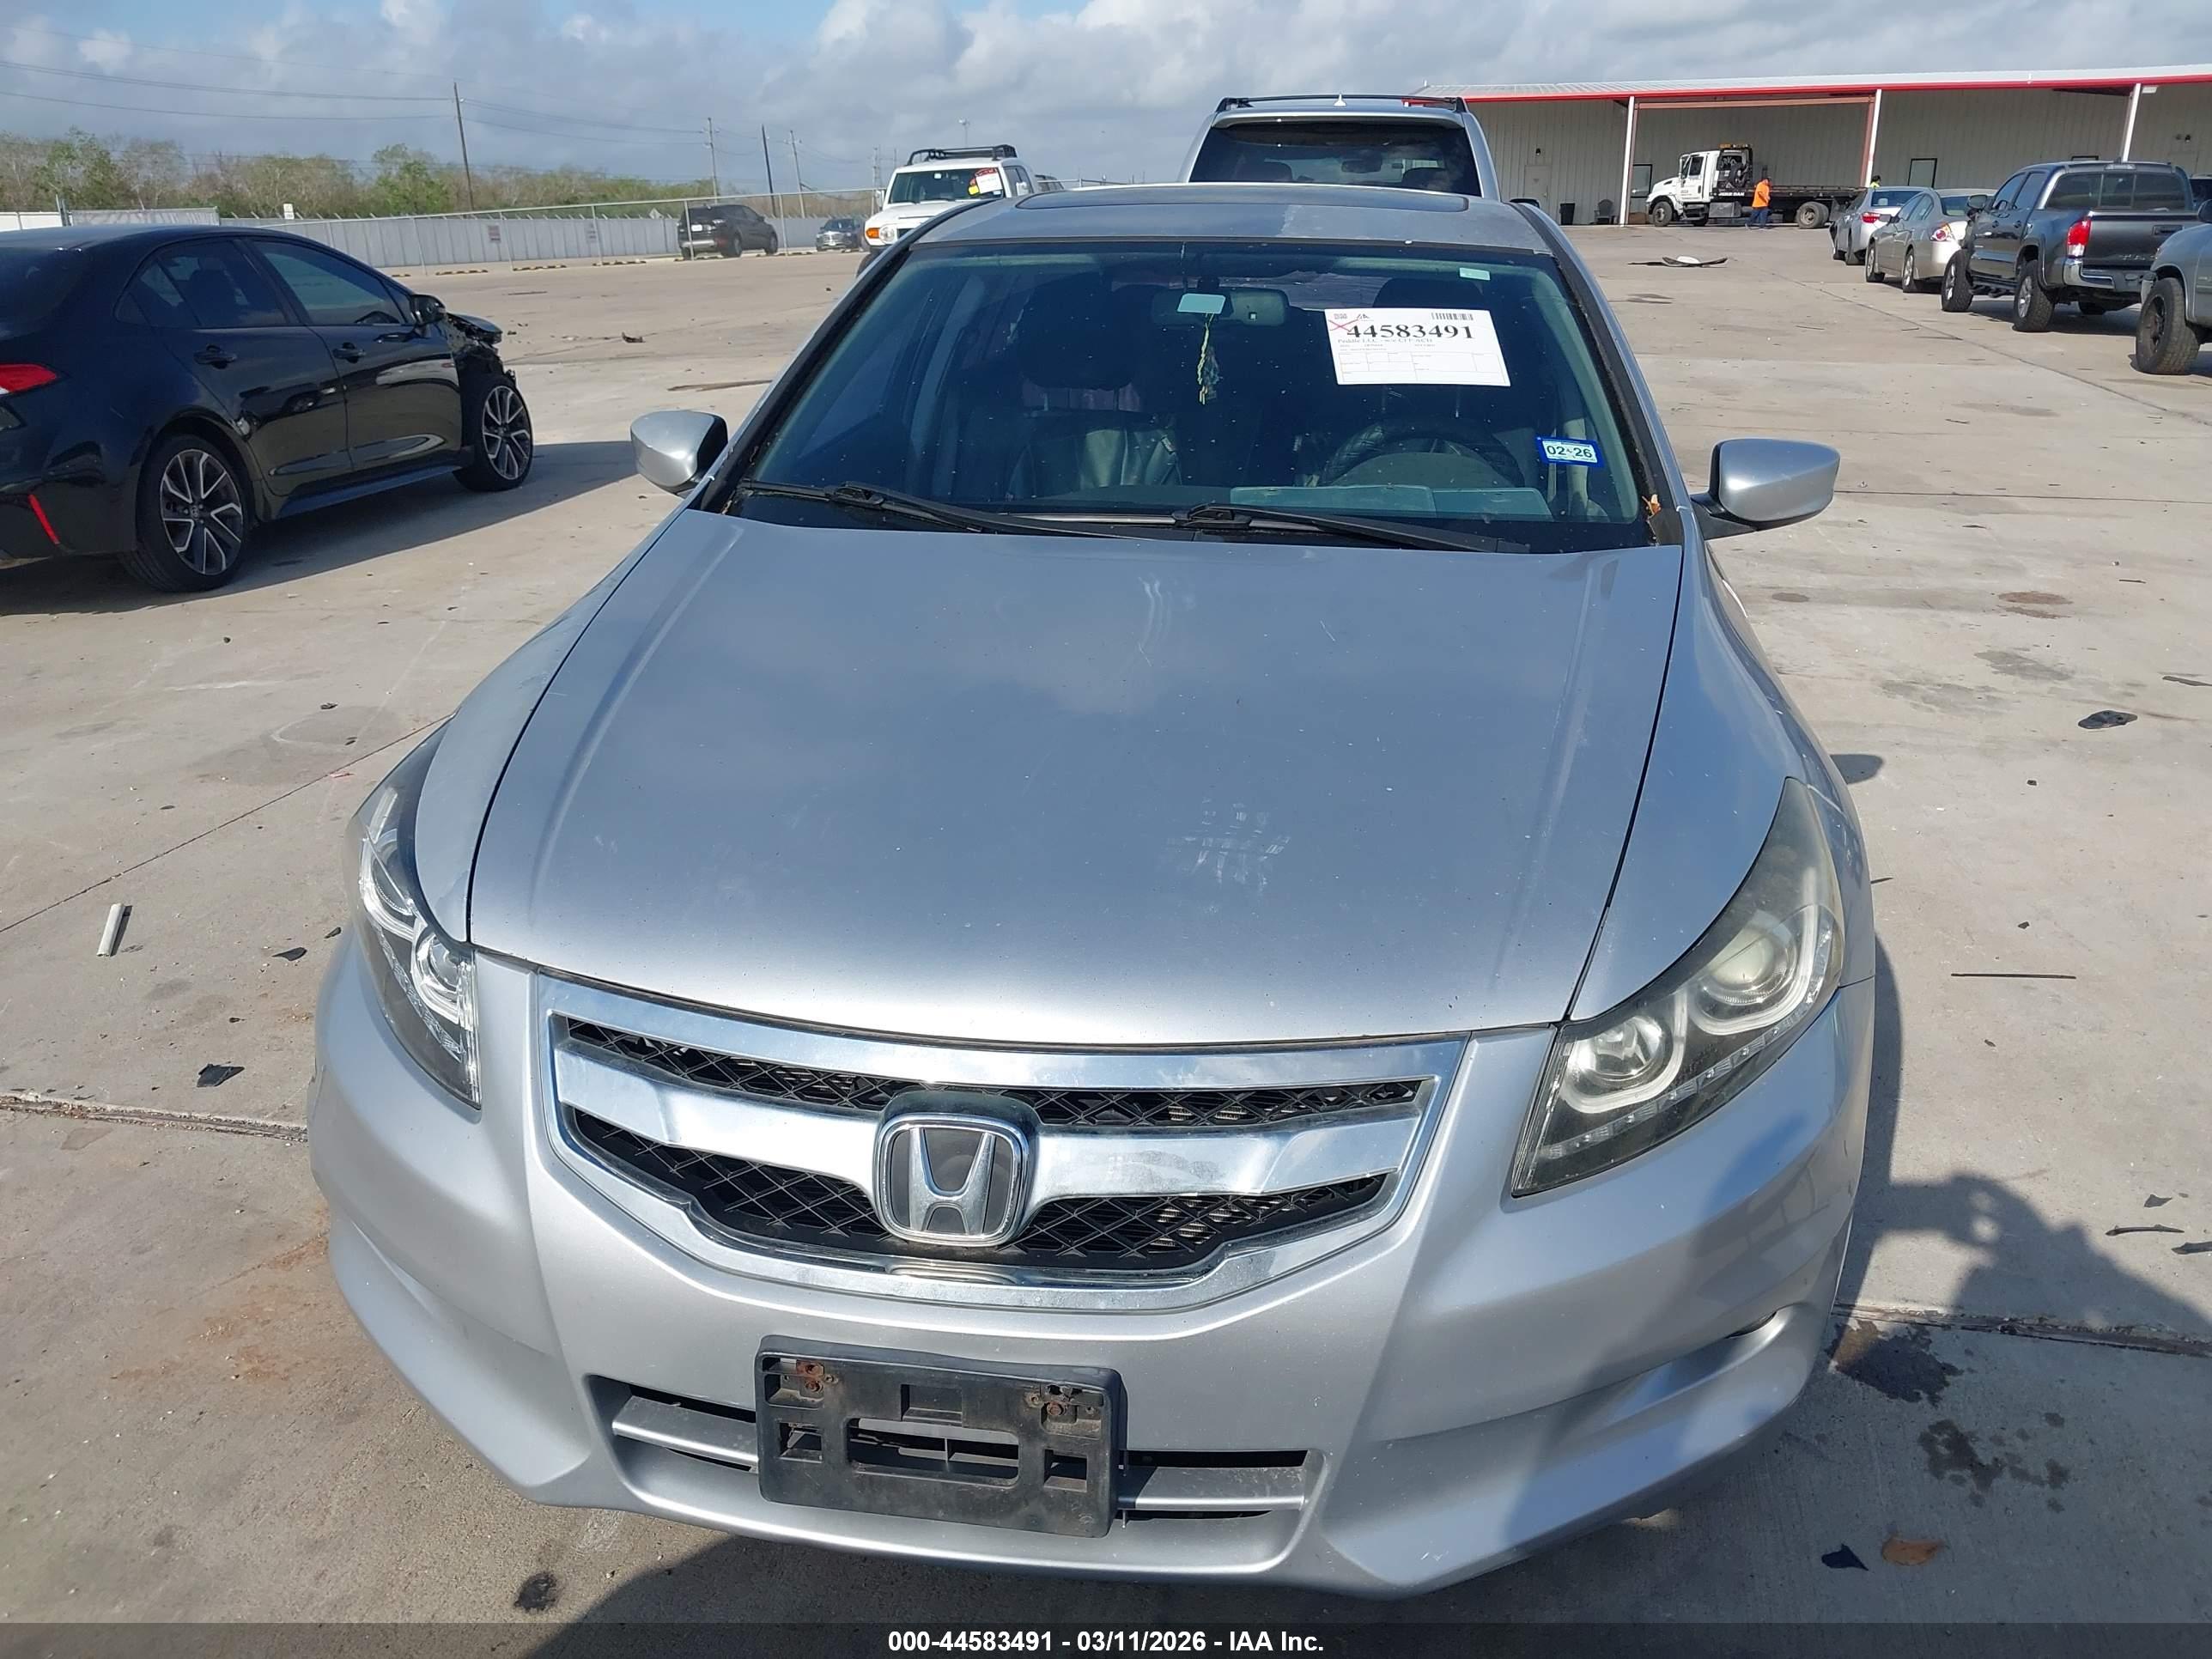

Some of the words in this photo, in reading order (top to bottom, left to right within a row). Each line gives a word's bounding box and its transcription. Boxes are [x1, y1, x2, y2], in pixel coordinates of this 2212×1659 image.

[1346, 324, 1474, 338] 44583491
[1547, 445, 1566, 456] 02
[1573, 447, 1593, 458] 26
